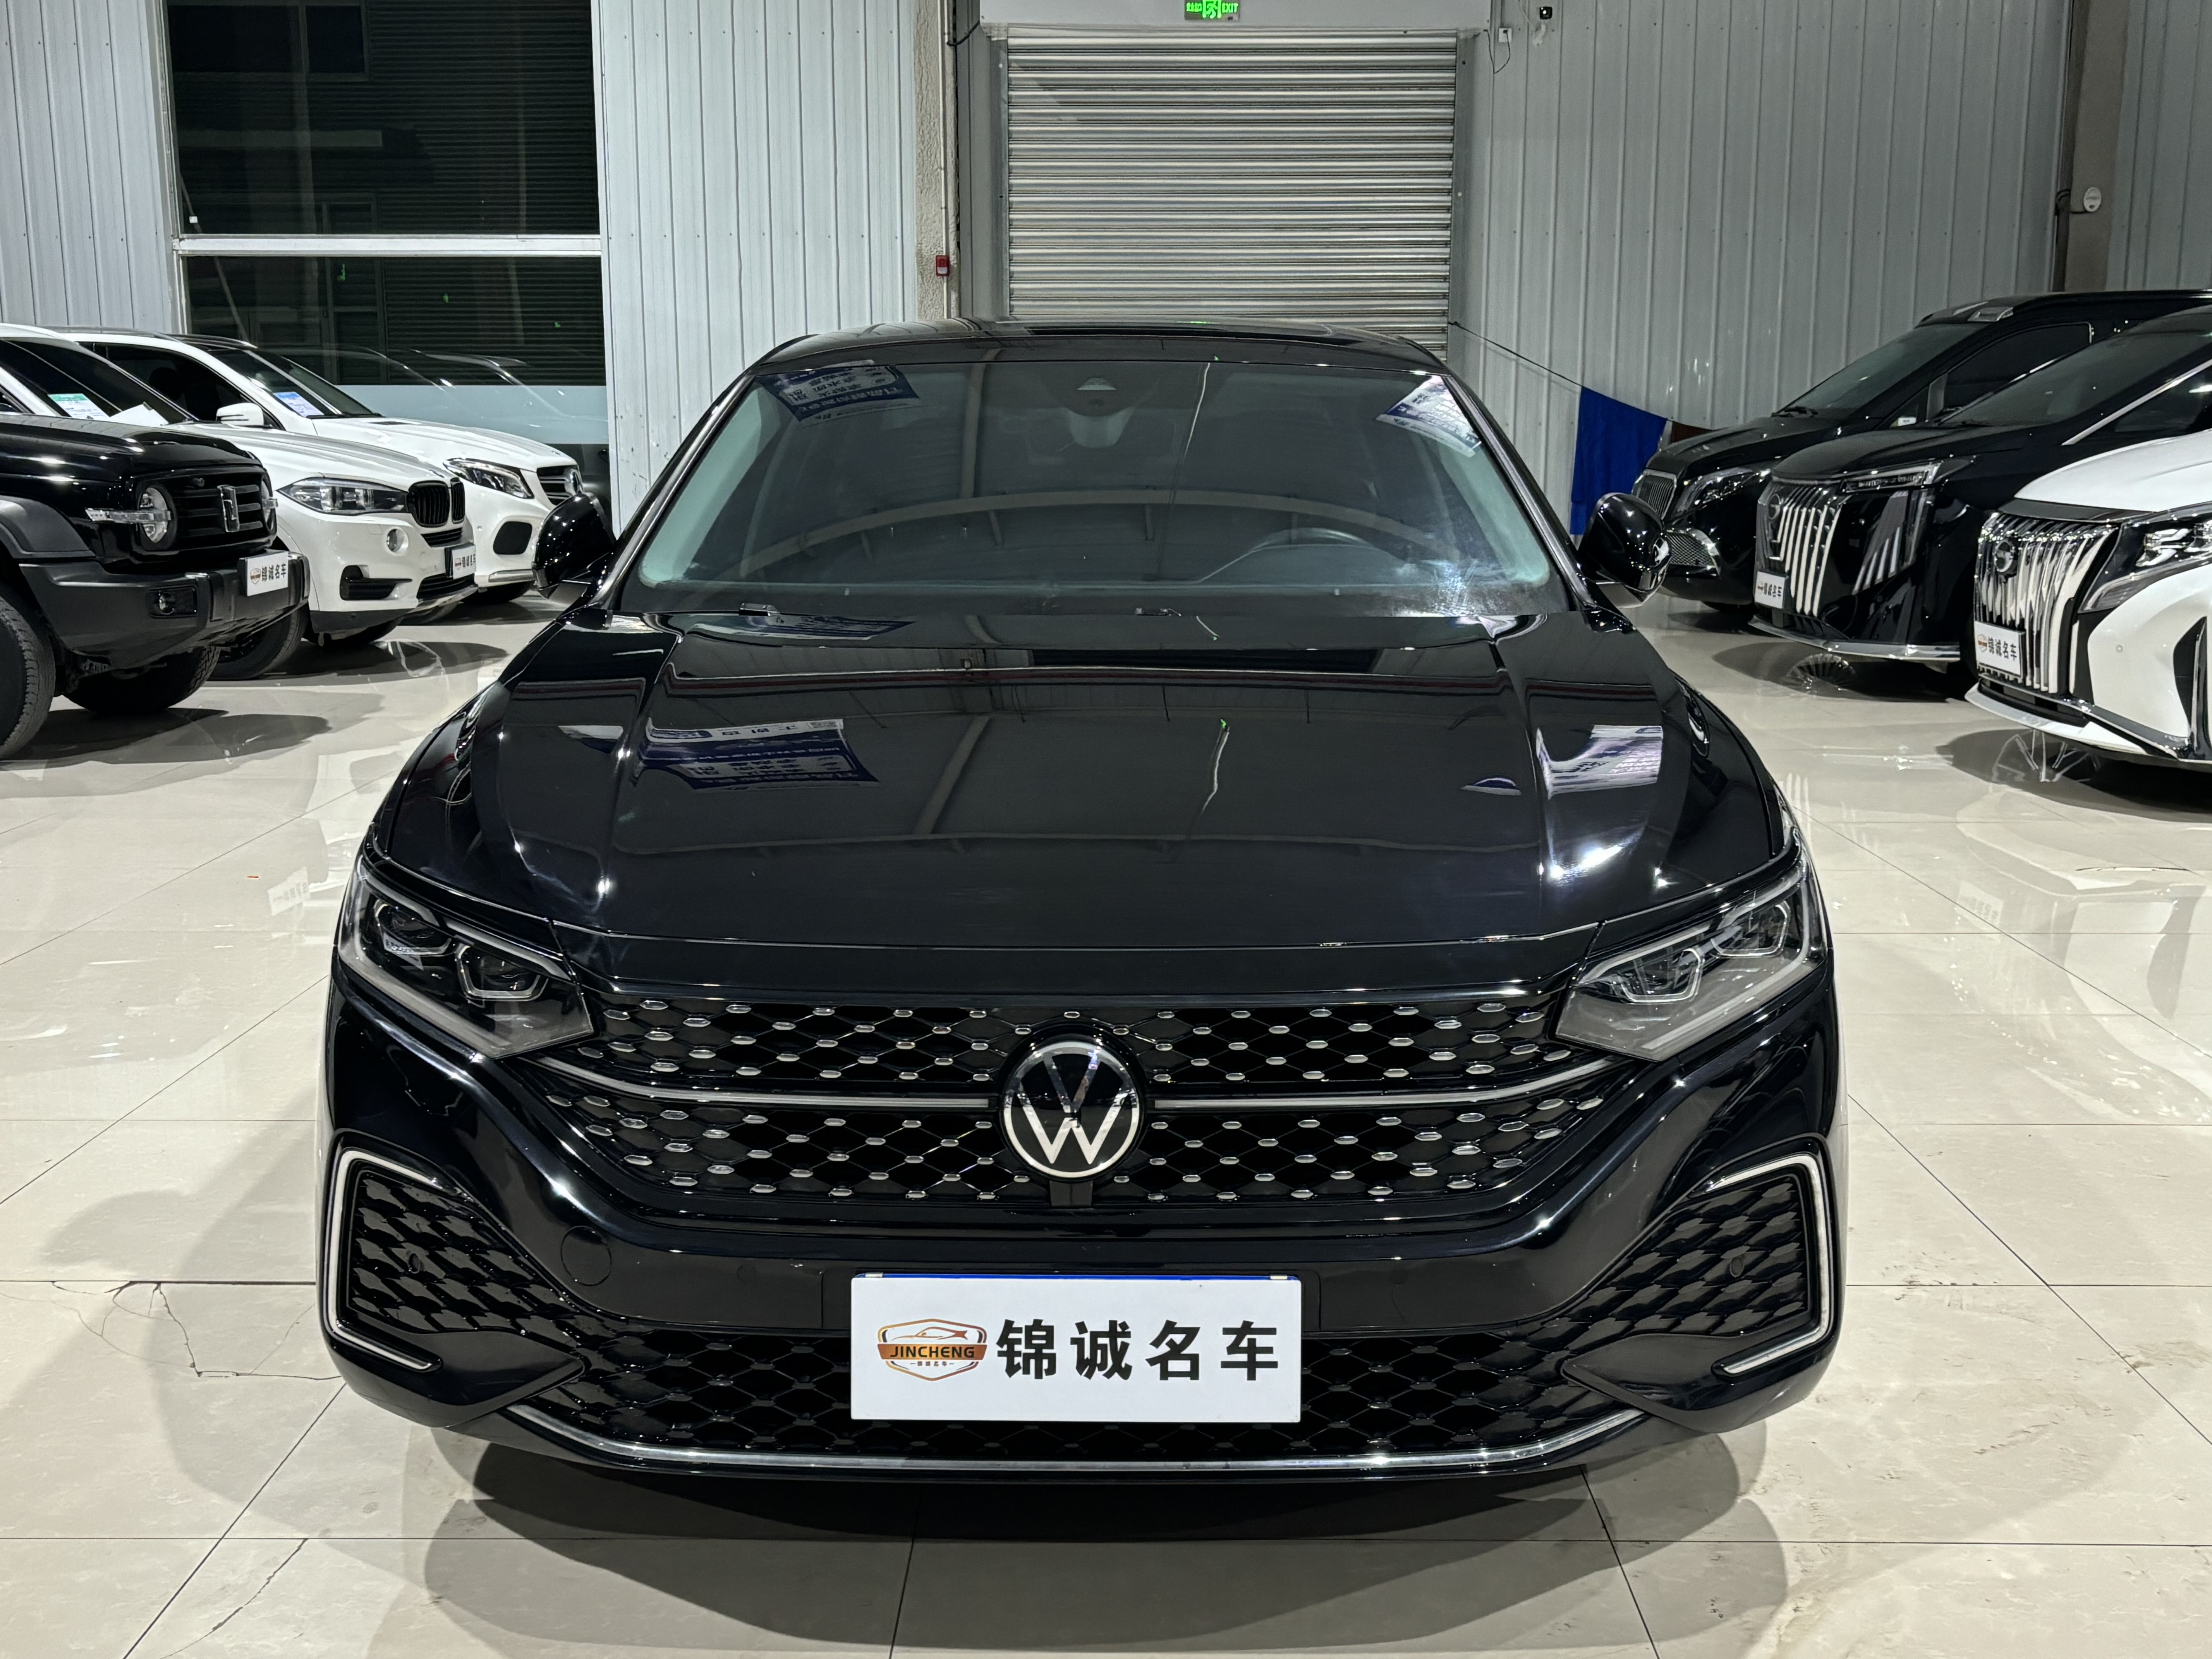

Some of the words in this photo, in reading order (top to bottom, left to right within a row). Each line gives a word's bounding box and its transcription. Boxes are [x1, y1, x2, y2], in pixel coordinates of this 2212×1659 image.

[1222, 3, 1238, 13] EXIT
[890, 1346, 974, 1358] JINCHENG
[996, 1319, 1278, 1381] 锦诚名车
